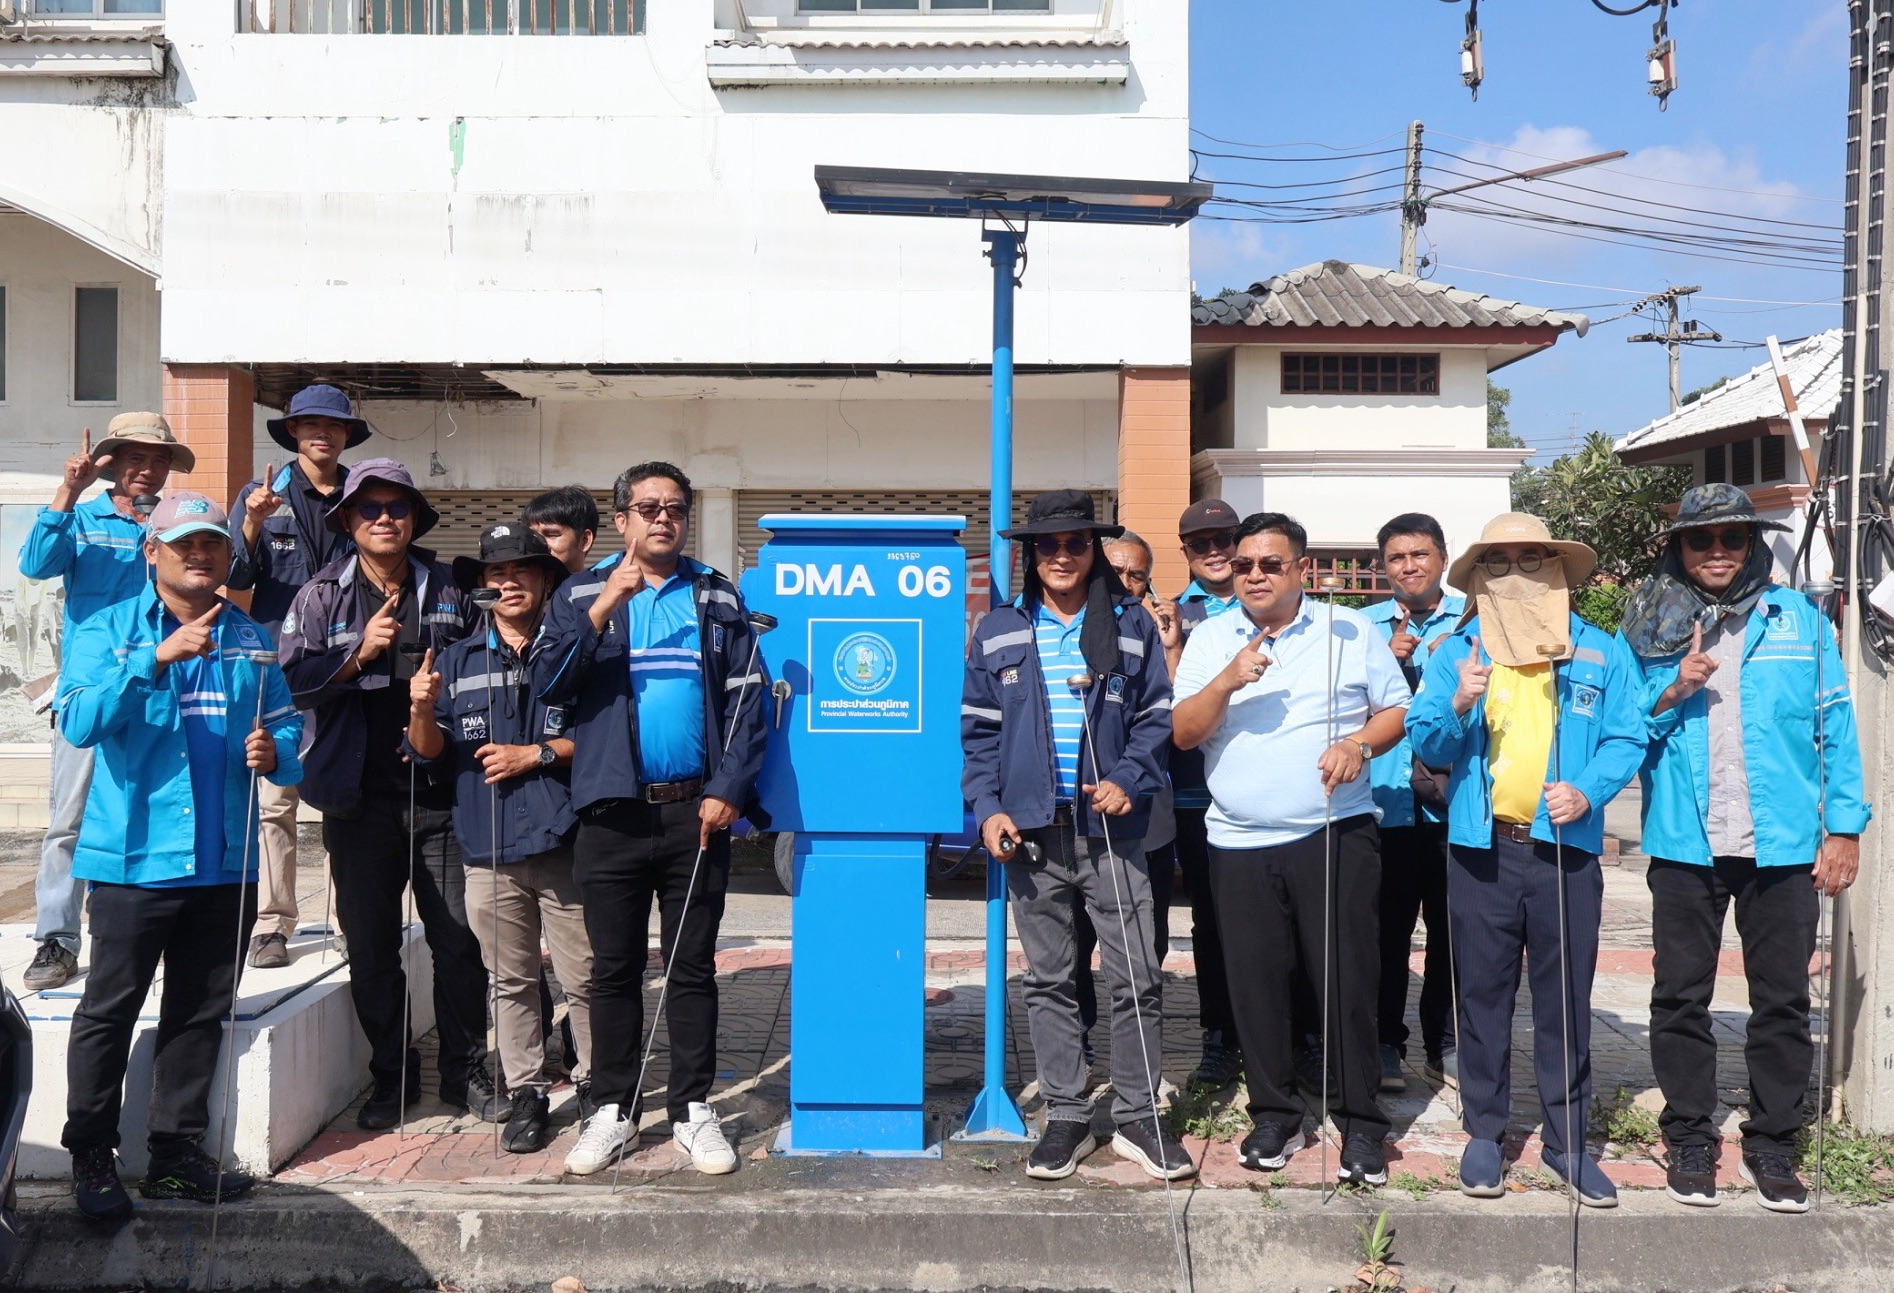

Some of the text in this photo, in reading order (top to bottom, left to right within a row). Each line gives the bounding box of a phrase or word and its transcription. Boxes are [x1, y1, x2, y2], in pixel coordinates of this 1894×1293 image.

[270, 541, 296, 550] 1662
[775, 563, 876, 597] DMA
[897, 564, 952, 598] 06
[820, 698, 910, 711] การประปาส่วนภูมิภาค
[882, 711, 909, 719] Authority
[462, 715, 485, 728] PWA
[463, 729, 487, 741] 1662
